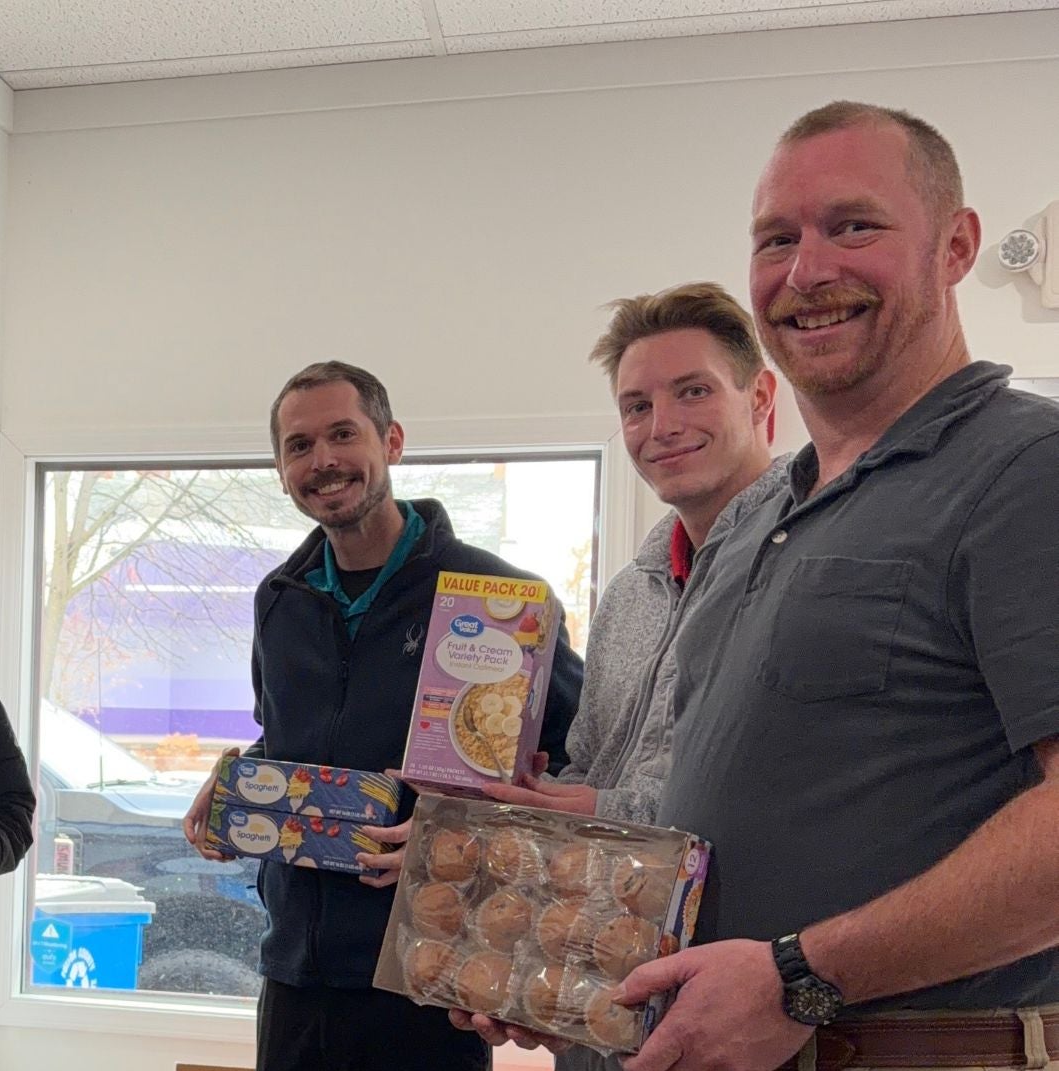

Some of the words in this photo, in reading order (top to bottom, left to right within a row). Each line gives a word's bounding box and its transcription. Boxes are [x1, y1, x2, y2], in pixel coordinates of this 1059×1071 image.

[443, 576, 481, 592] VALUE
[483, 580, 519, 597] PACK
[439, 596, 455, 608] 20
[454, 618, 479, 630] Great
[446, 641, 468, 652] Fruit
[469, 643, 476, 652] &
[479, 644, 513, 657] Cream
[448, 650, 482, 664] Variety
[483, 654, 509, 665] Pack
[244, 781, 279, 793] Spaghetti
[236, 830, 271, 842] Spaghetti
